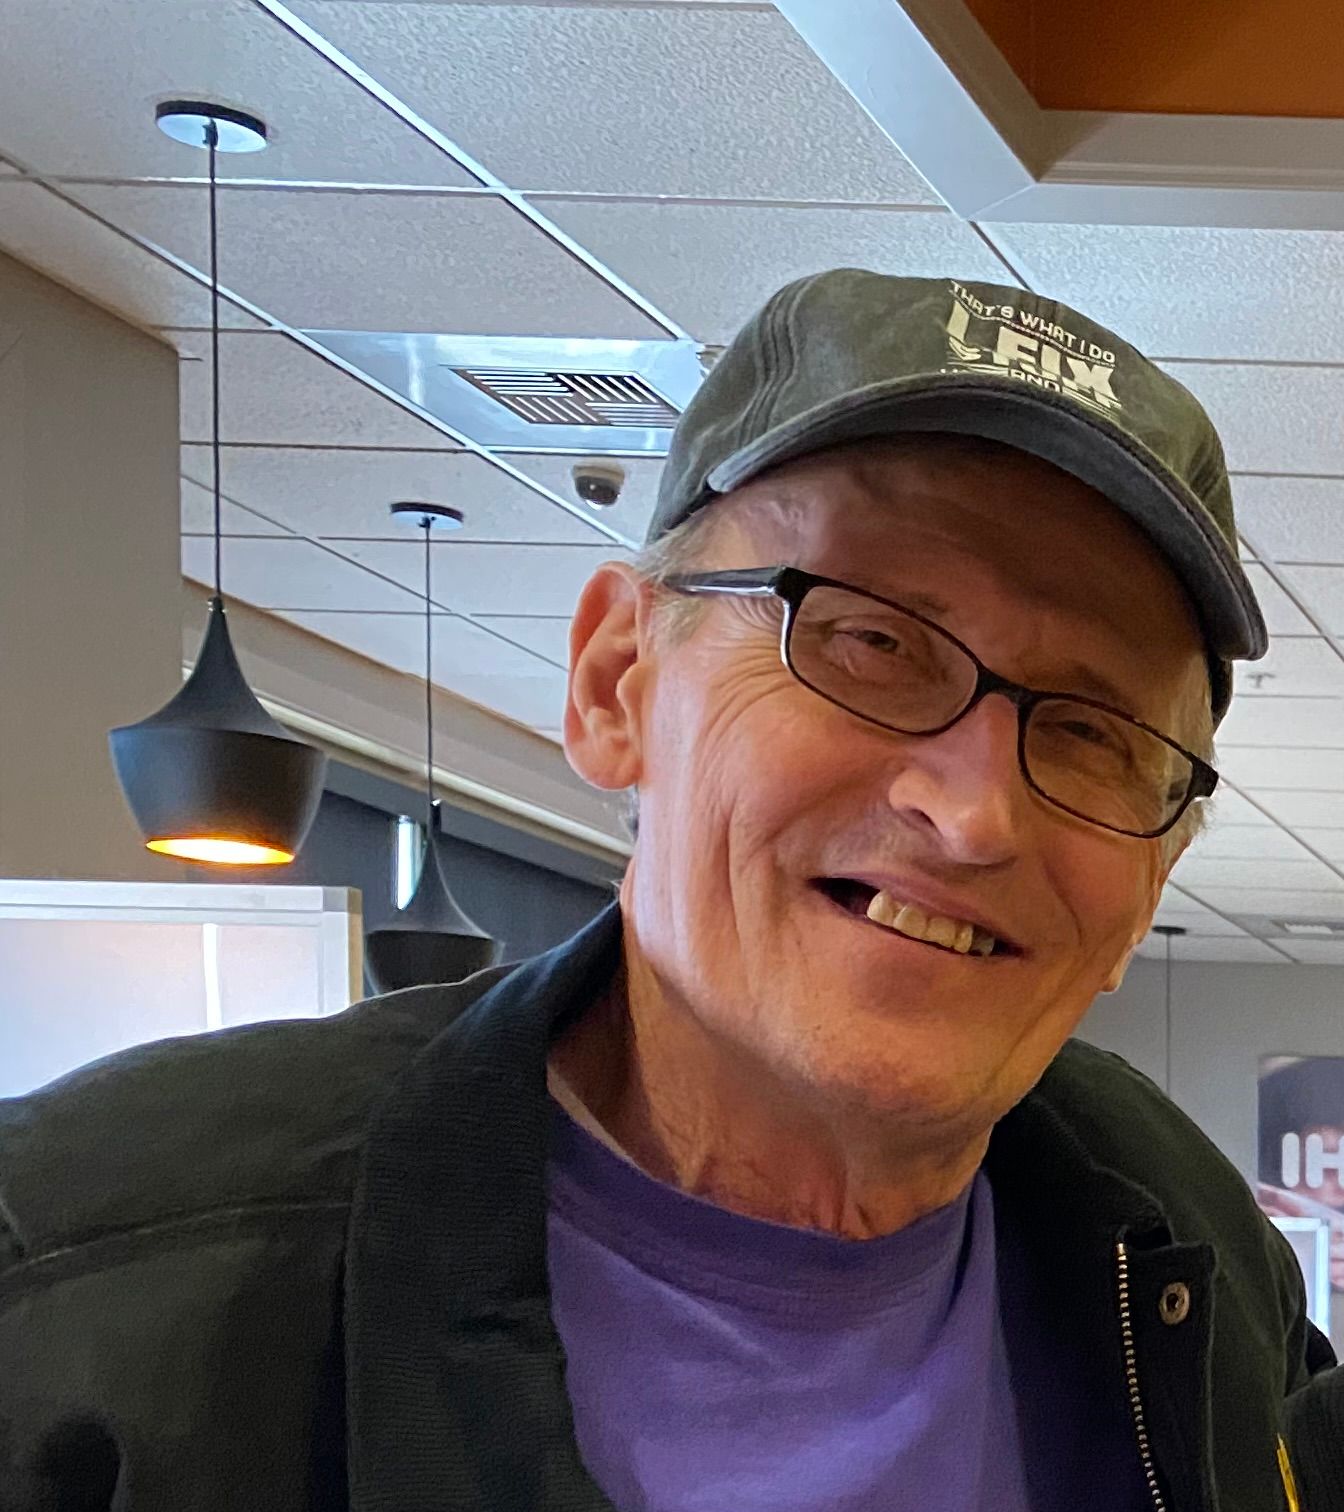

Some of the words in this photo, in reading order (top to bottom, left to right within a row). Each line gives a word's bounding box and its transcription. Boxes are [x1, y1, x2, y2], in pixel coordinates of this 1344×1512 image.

[951, 280, 1014, 319] THAT'S
[1020, 311, 1077, 348] WHAT
[1088, 344, 1116, 364] DO
[993, 325, 1122, 409] FIX
